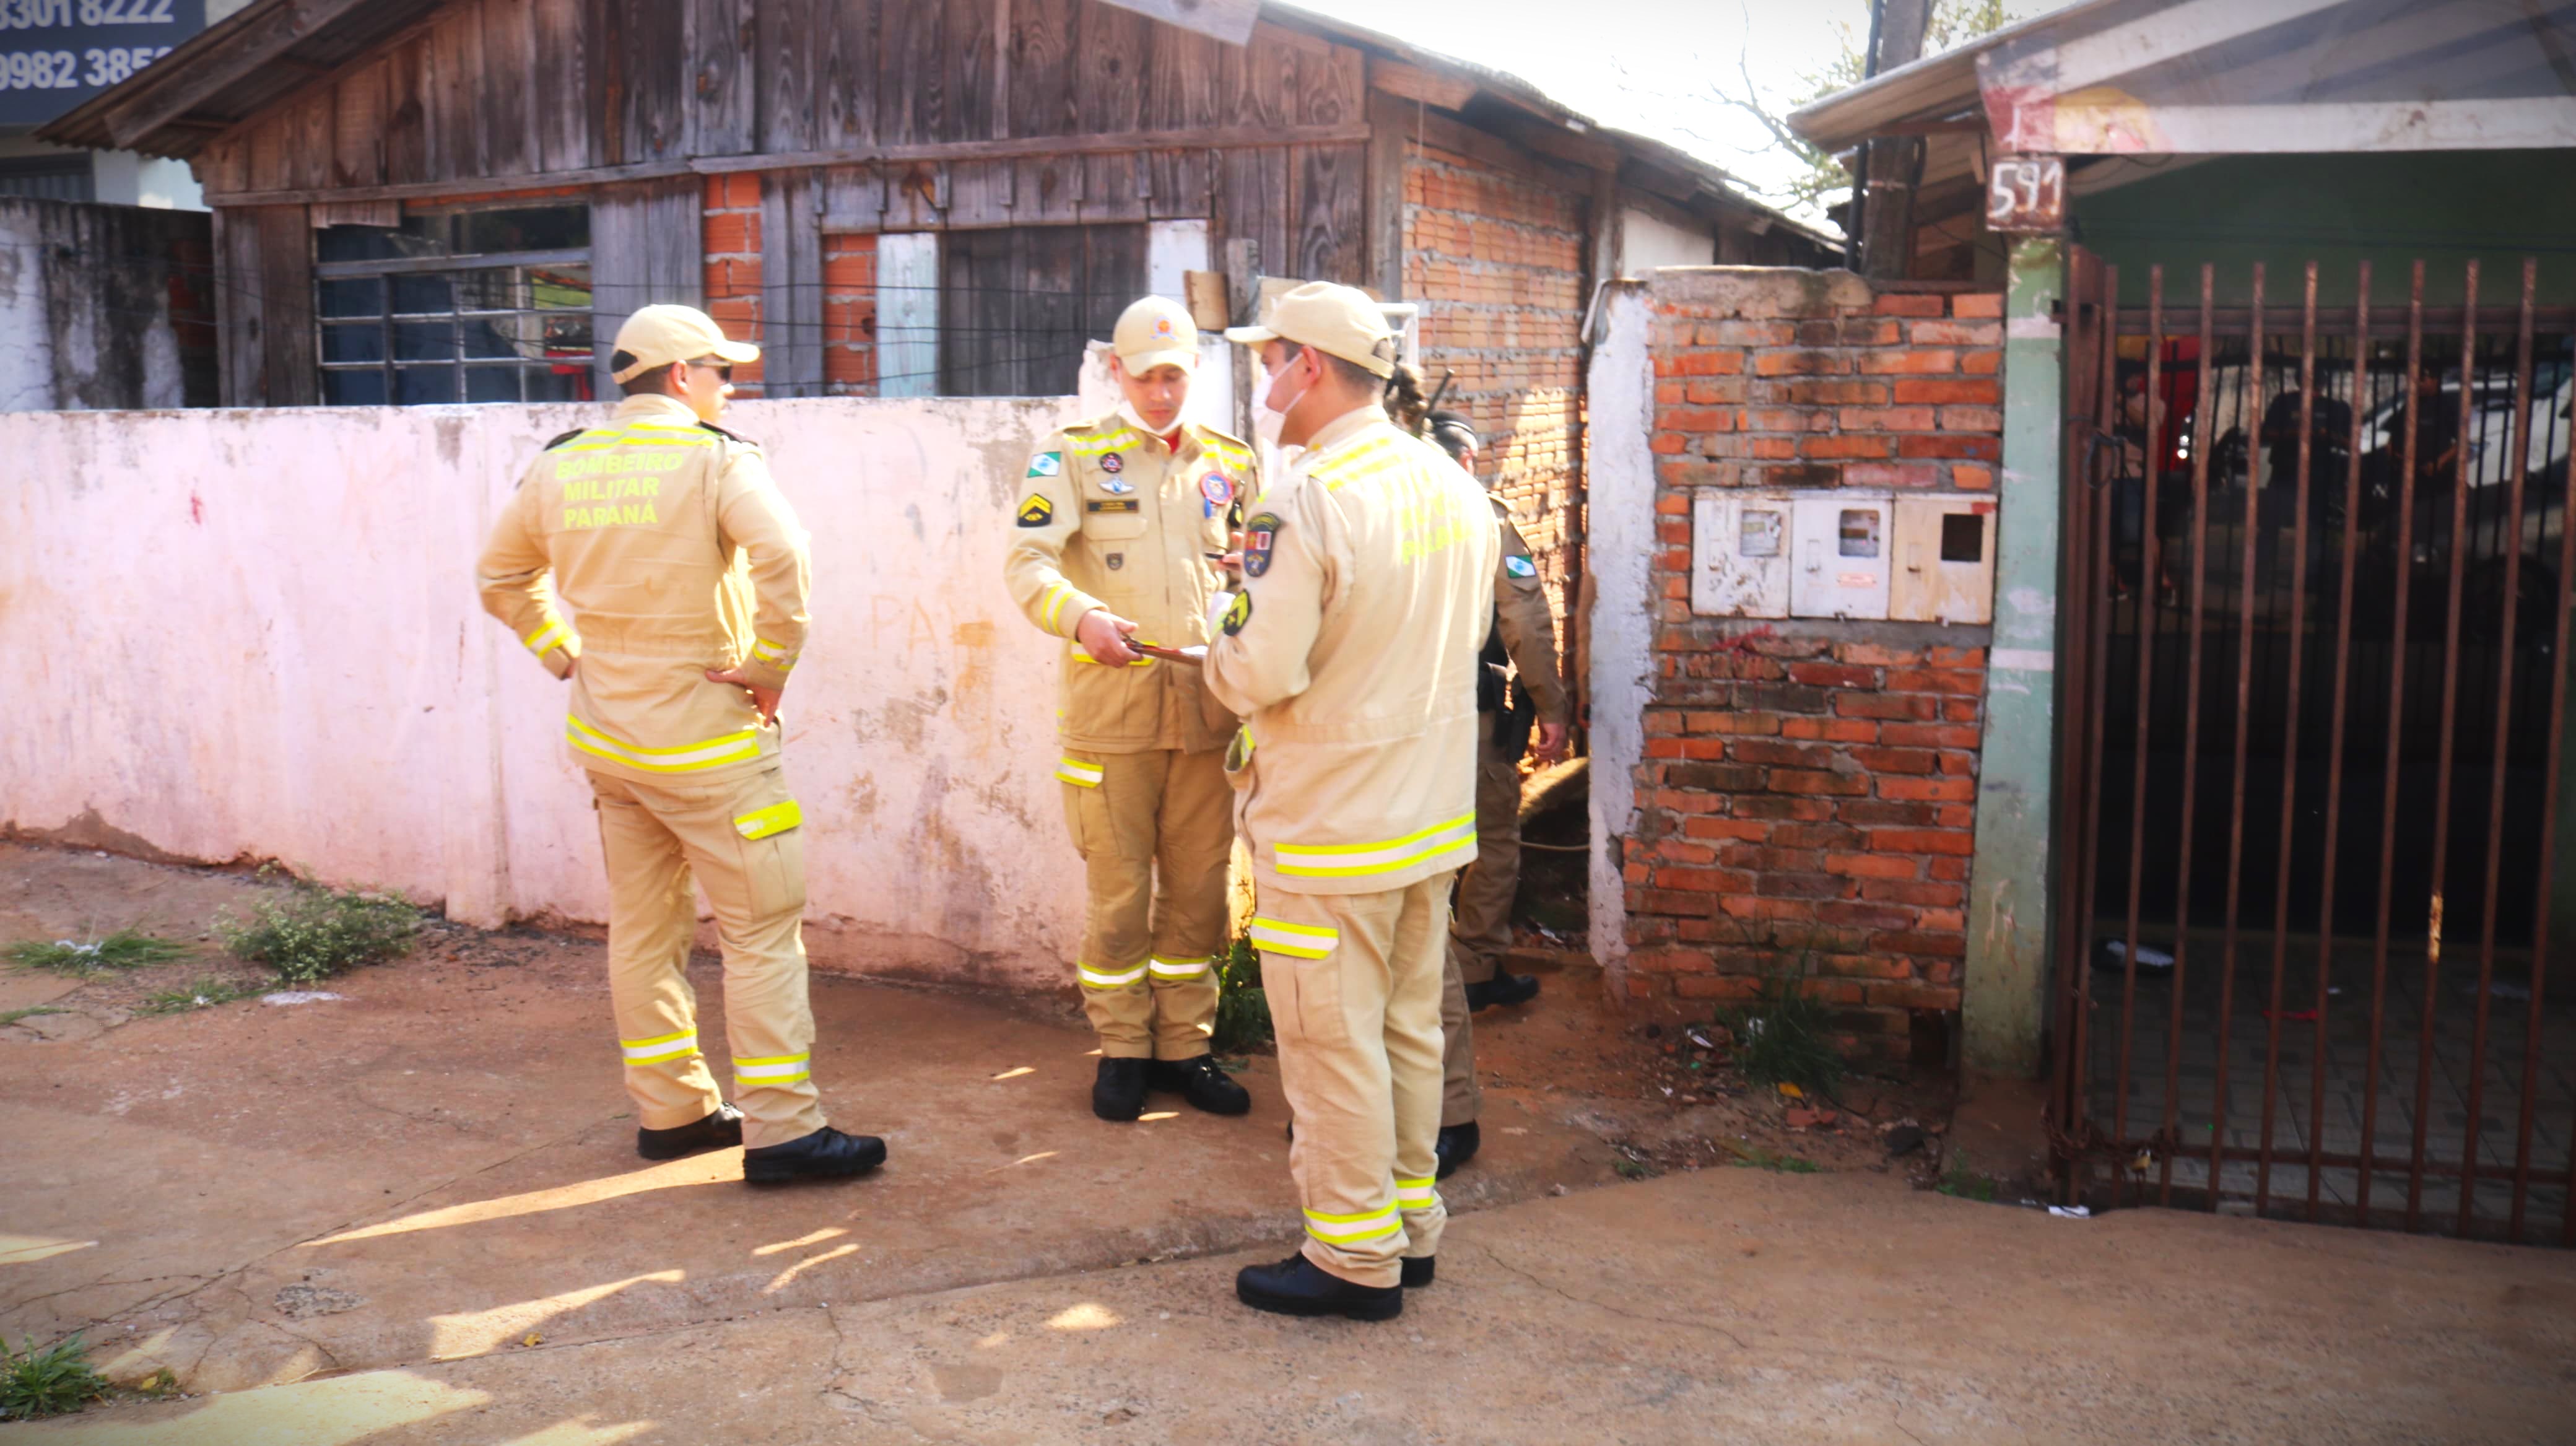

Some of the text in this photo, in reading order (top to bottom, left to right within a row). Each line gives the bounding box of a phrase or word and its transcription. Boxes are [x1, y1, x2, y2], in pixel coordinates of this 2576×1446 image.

[84, 46, 173, 86] 385
[1987, 160, 2063, 217] 591
[557, 453, 682, 479] BOMBEIRO
[565, 478, 659, 502] MILITAR
[565, 500, 658, 528] PARANÁ
